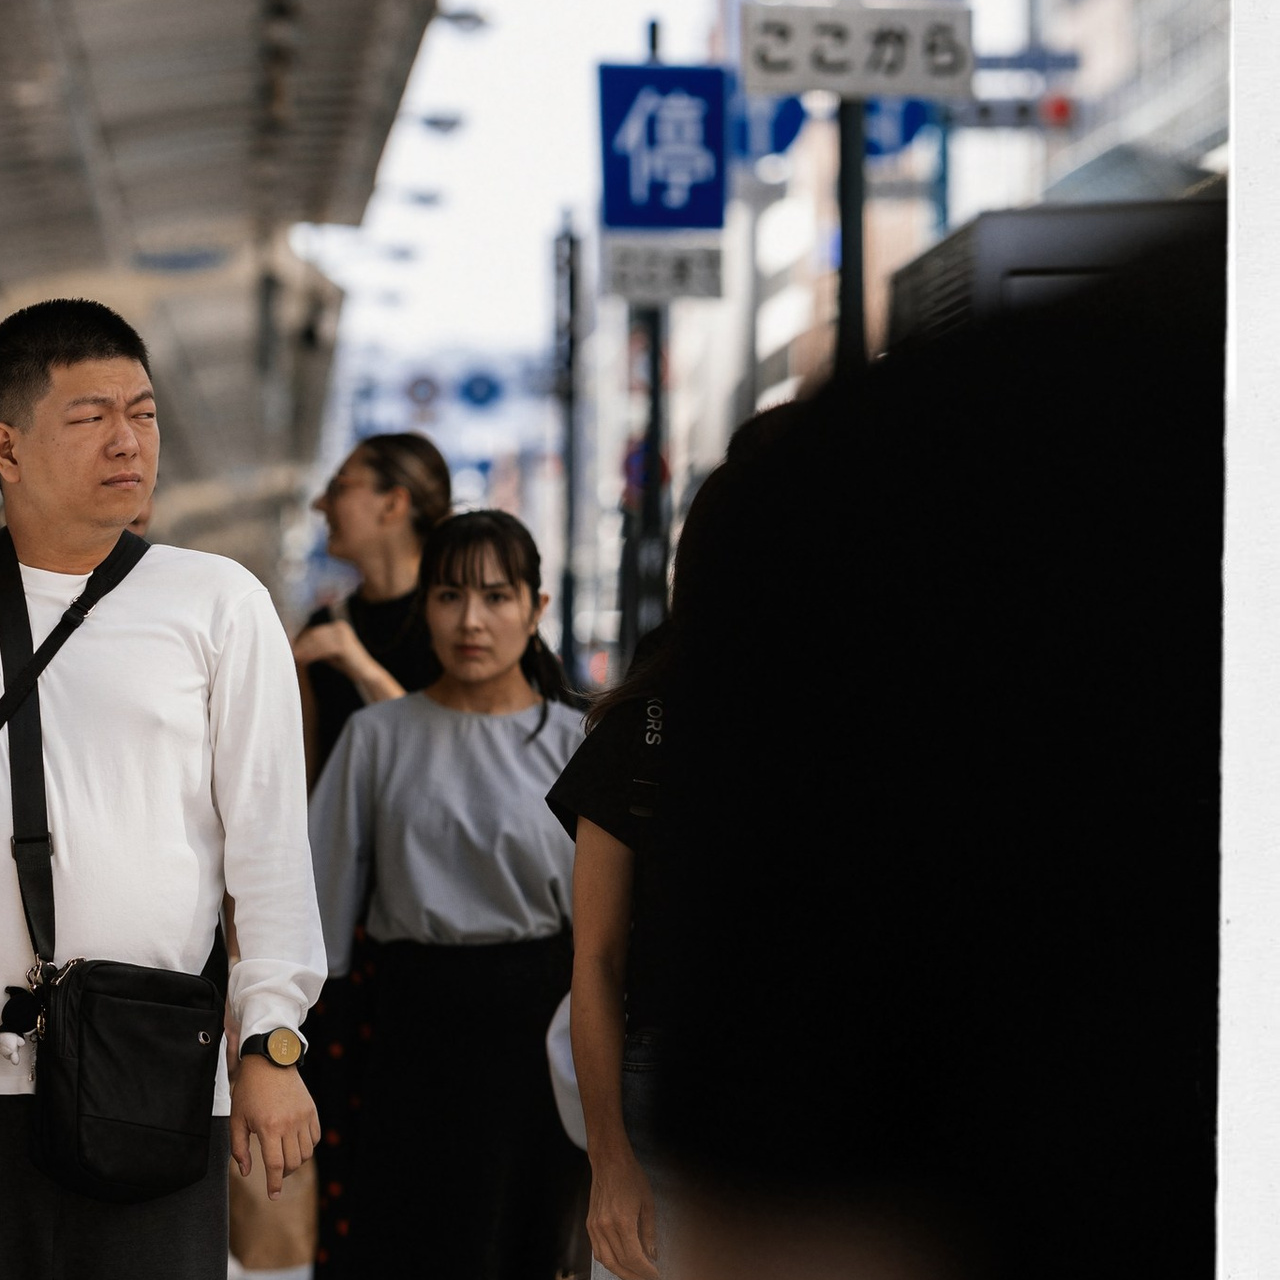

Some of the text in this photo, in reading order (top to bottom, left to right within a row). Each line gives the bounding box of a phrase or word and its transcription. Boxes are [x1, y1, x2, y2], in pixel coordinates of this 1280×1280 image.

[754, 20, 967, 77] ここから
[612, 85, 716, 209] 停
